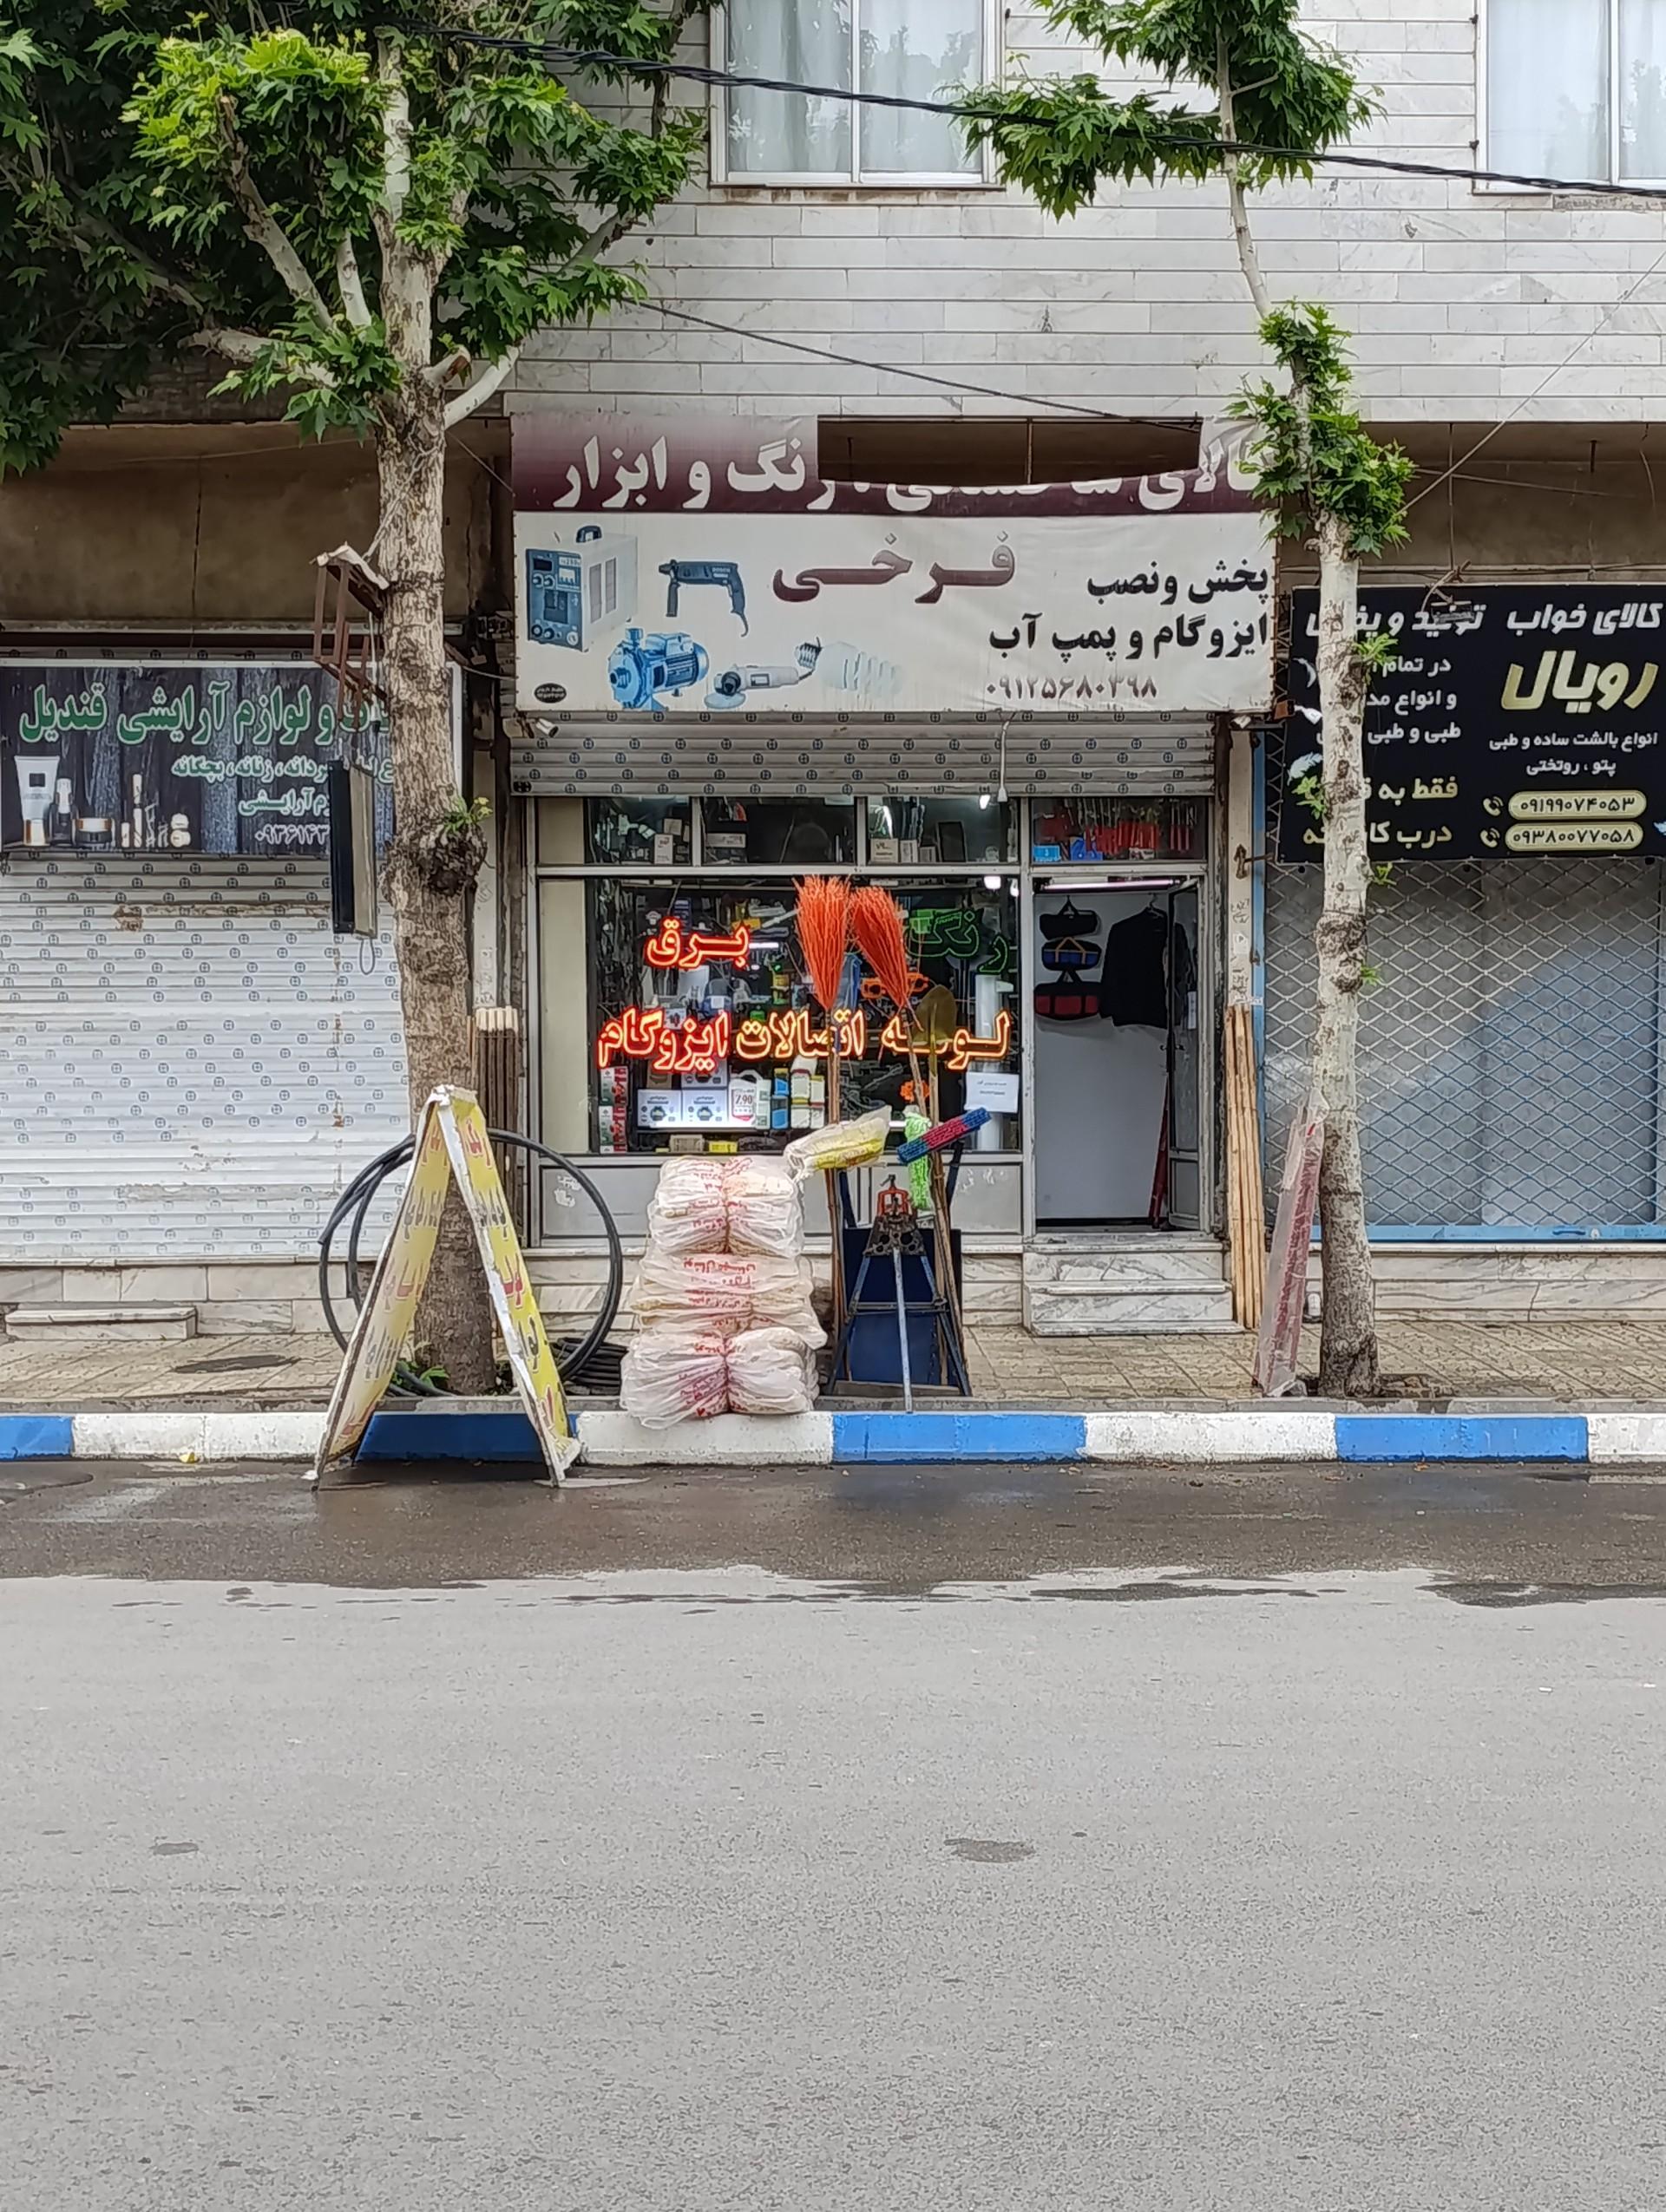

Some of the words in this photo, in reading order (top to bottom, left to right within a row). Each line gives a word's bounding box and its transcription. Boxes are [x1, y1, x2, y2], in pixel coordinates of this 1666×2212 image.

[554, 435, 667, 508] ابزار
[683, 460, 712, 509] و
[772, 530, 1015, 605] فرخی
[1188, 559, 1269, 604] پخش
[1388, 611, 1405, 637] و
[1507, 603, 1587, 637] خواب
[1592, 603, 1663, 635] کالای
[989, 612, 1043, 659] آب
[1052, 626, 1117, 664] پمپ
[1125, 630, 1143, 659] و
[1153, 612, 1267, 659] ایزوگام
[1427, 658, 1452, 677] در
[1501, 650, 1659, 714] رویال
[19, 681, 108, 743] قندیل
[117, 680, 231, 745] آرایشی
[234, 684, 312, 745] لوازم
[1394, 690, 1441, 716] انواع
[1446, 693, 1458, 710] و
[315, 704, 336, 745] و
[1368, 723, 1405, 745] طبی
[1408, 727, 1420, 744] و
[1424, 722, 1461, 744] طبی
[1489, 732, 1519, 750] طبی
[1521, 736, 1531, 750] و
[1533, 732, 1570, 747] ساده
[1572, 730, 1619, 749] بالشت
[1620, 731, 1658, 753] انواع
[276, 756, 328, 782] ردانه،
[1525, 758, 1580, 776] روتختی
[1591, 759, 1617, 777] پتو
[1378, 783, 1406, 806] به
[1412, 776, 1459, 800] فقط
[1520, 796, 1635, 813] ۰۹۱۹۹۰۷۴۰۵۳
[1396, 826, 1453, 849] درب
[1513, 828, 1634, 844] ۰۹۳۸۰۰۷۷۰۵۸
[646, 917, 751, 969] برق
[598, 1007, 731, 1073] ایزوگام
